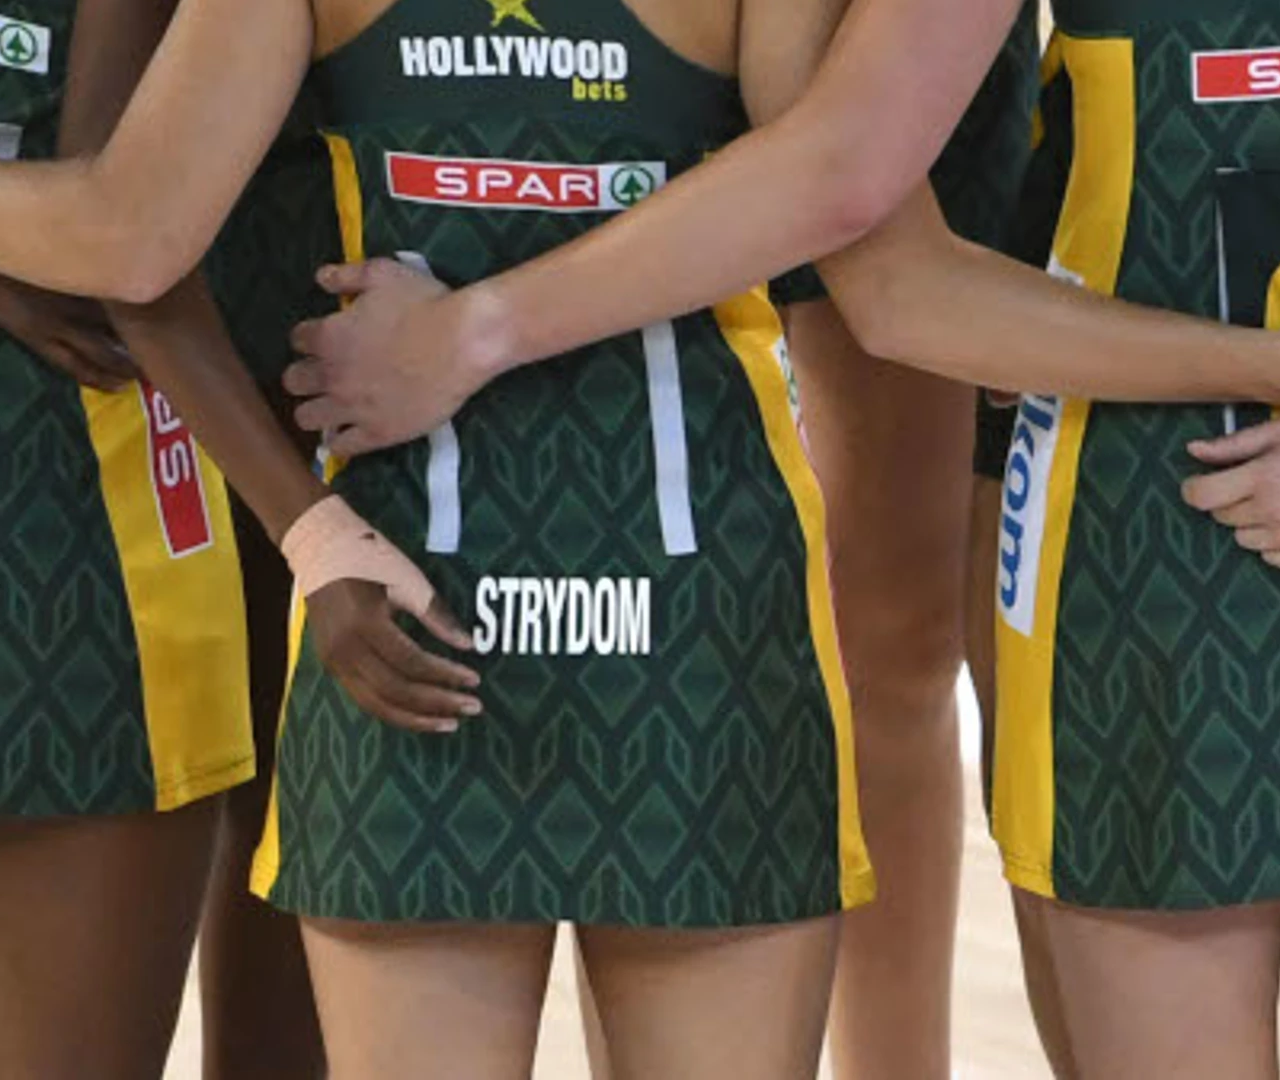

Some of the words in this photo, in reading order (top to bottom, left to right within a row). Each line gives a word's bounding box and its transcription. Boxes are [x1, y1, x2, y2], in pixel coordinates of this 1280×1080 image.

[400, 35, 628, 80] HOLLYWOOD
[572, 77, 628, 101] bets
[434, 166, 596, 201] SPAR
[152, 389, 192, 489] SP
[472, 575, 651, 656] STRYDOM
